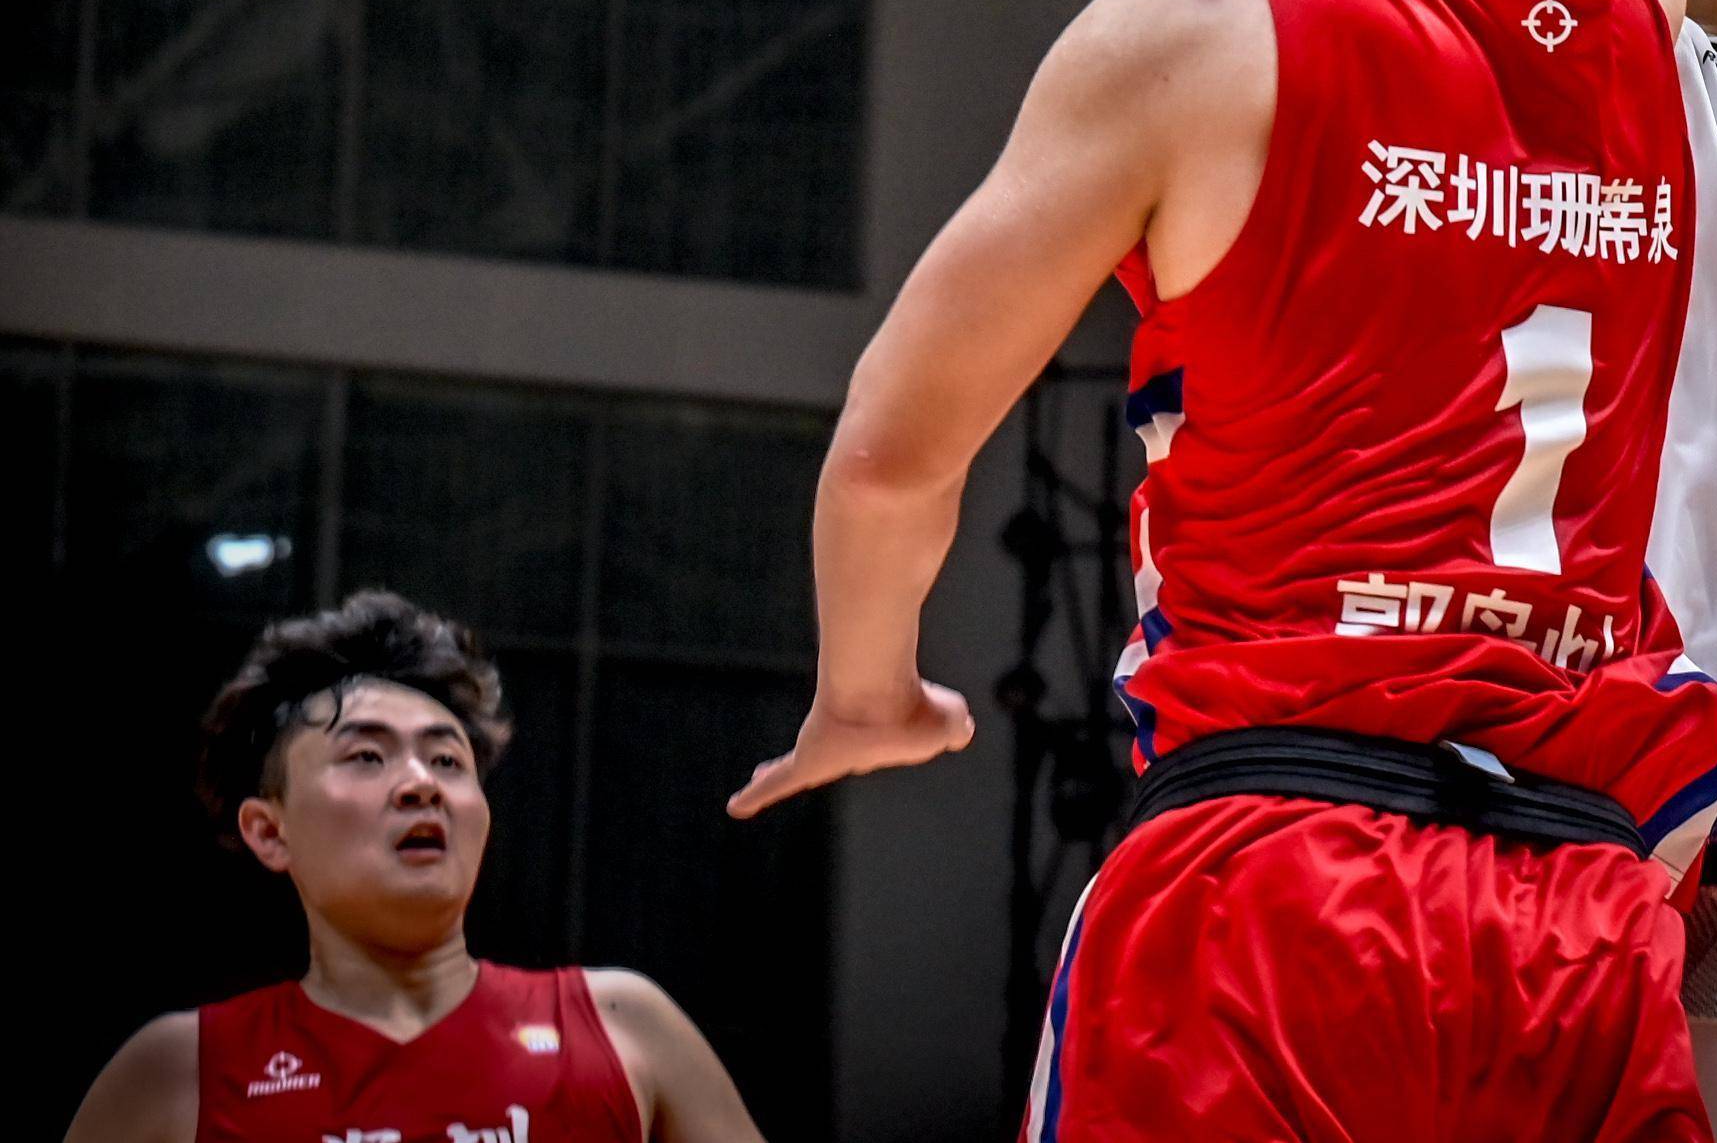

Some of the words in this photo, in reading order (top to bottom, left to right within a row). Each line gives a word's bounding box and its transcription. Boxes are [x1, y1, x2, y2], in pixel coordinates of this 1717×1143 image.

[1357, 139, 1679, 265] 深圳珊蒂泉
[1489, 303, 1594, 576] 1
